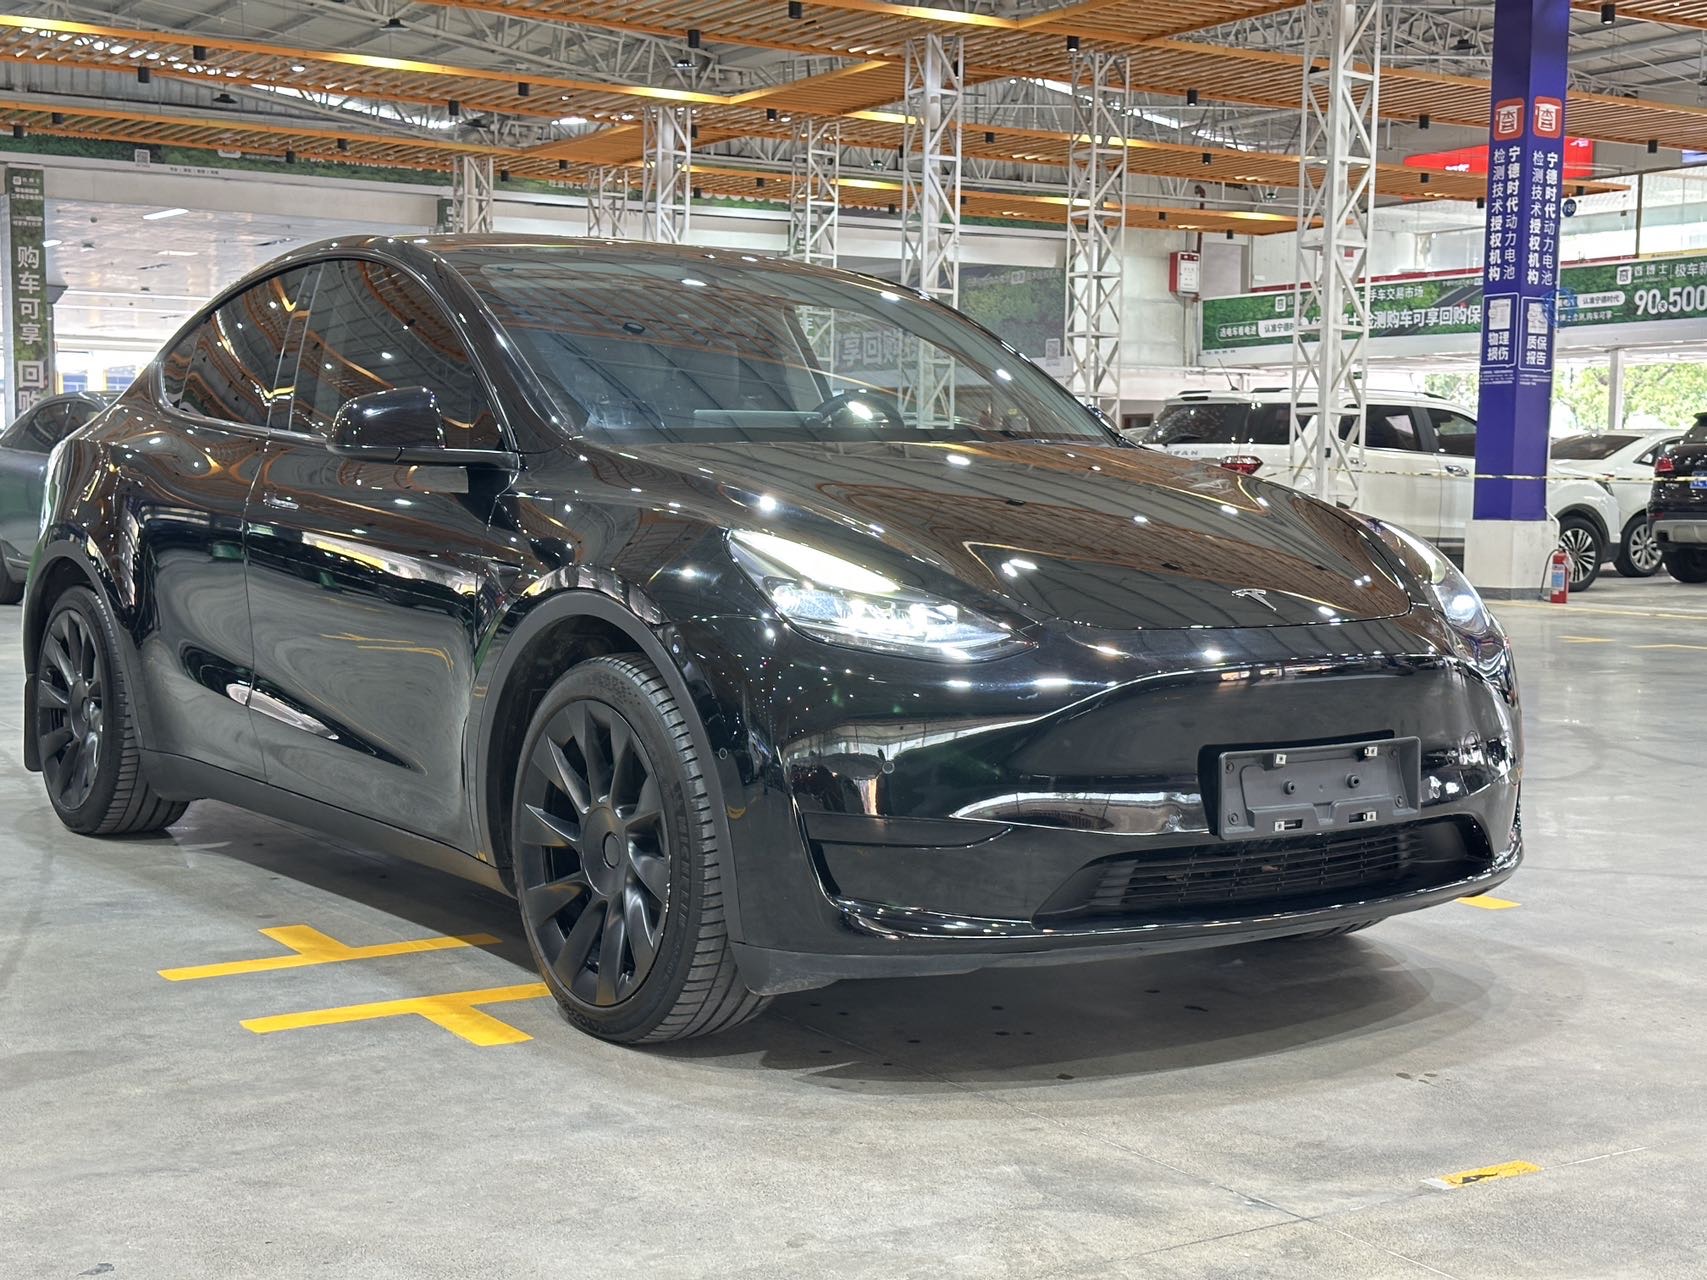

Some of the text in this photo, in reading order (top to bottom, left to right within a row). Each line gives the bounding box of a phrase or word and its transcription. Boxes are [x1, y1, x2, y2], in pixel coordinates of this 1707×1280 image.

[1488, 148, 1505, 281] 检测技术授权机构
[1503, 146, 1520, 280] 宁德时代动力电池
[1527, 150, 1544, 285] 检测技术授权机构
[1541, 152, 1558, 286] 宁德时代动力电池
[17, 246, 41, 345] 购车可享
[1356, 285, 1424, 301] 二手车交易市场
